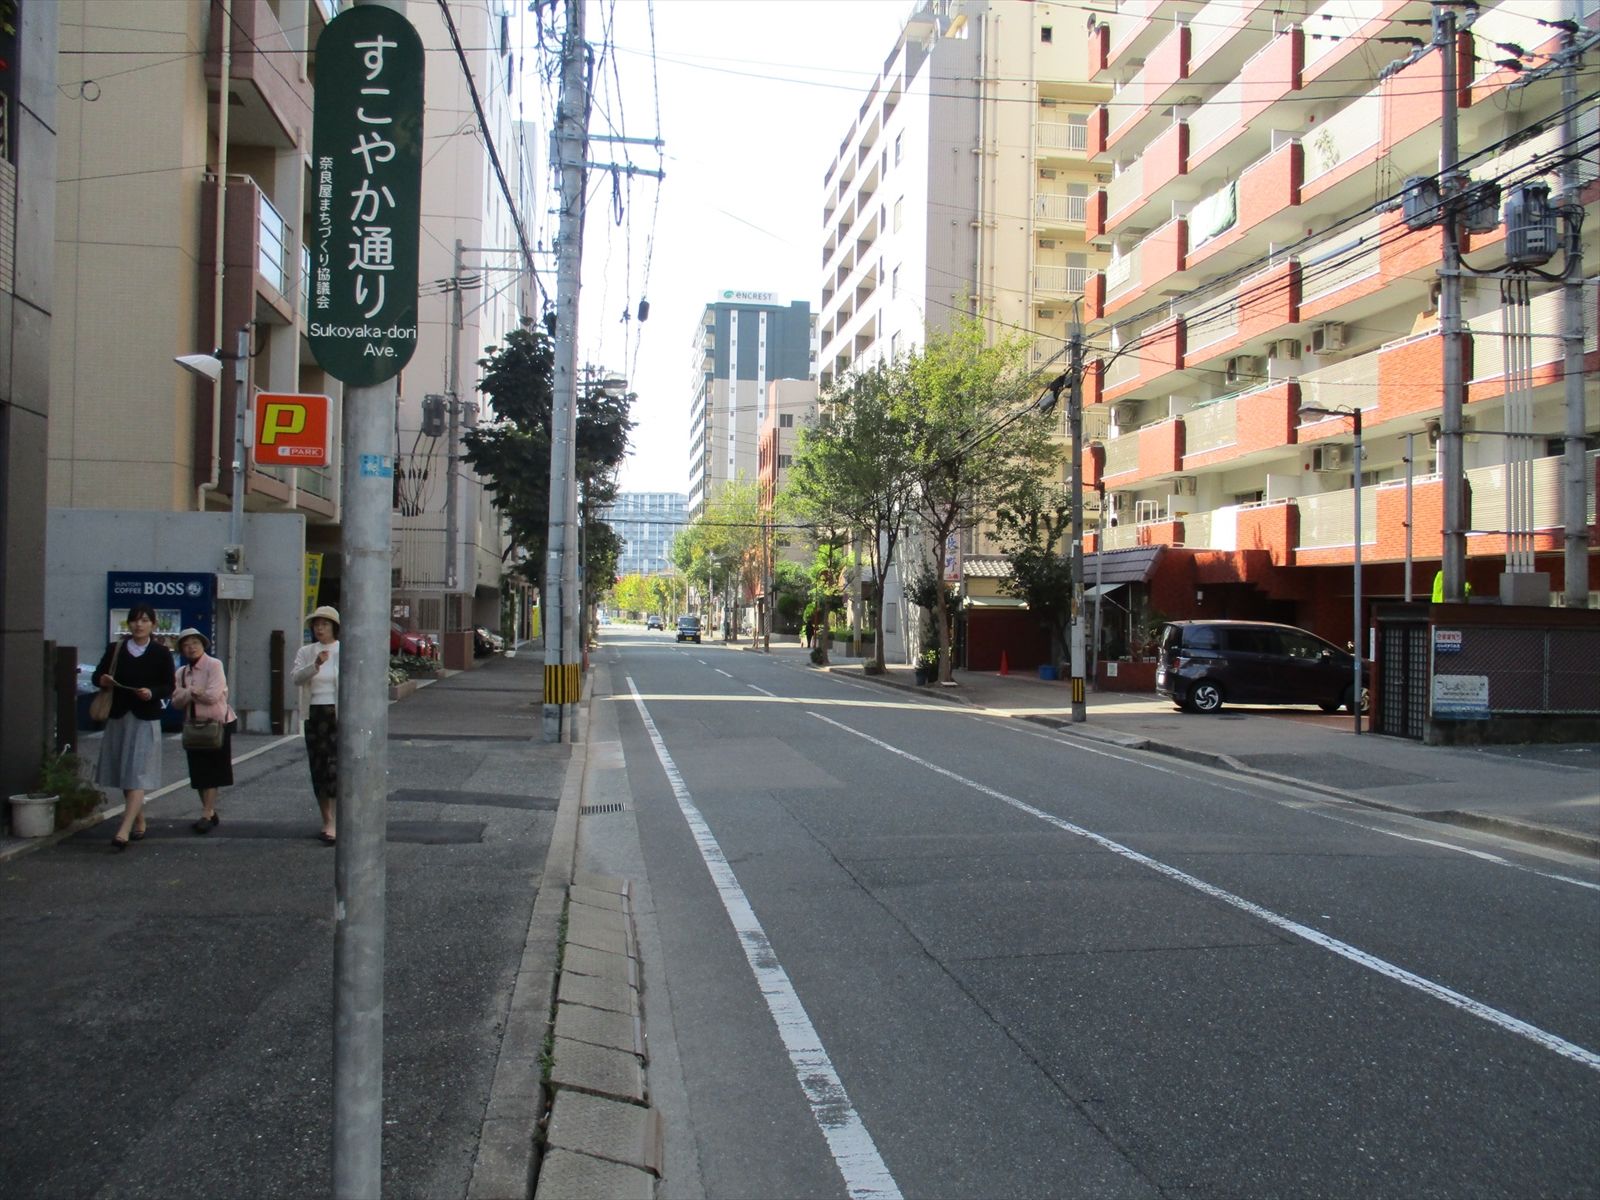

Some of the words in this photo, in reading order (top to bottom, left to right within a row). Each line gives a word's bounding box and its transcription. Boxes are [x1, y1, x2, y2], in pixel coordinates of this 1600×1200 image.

[348, 34, 398, 319] すこやか通り
[316, 156, 334, 309] 奈良屋まちづくり協議会
[310, 322, 417, 340] Sukoyaka-dori
[363, 343, 399, 358] Ave.
[260, 403, 307, 445] P
[290, 448, 320, 456] PARK
[114, 587, 142, 595] COFFEE
[143, 582, 185, 596] BOSS
